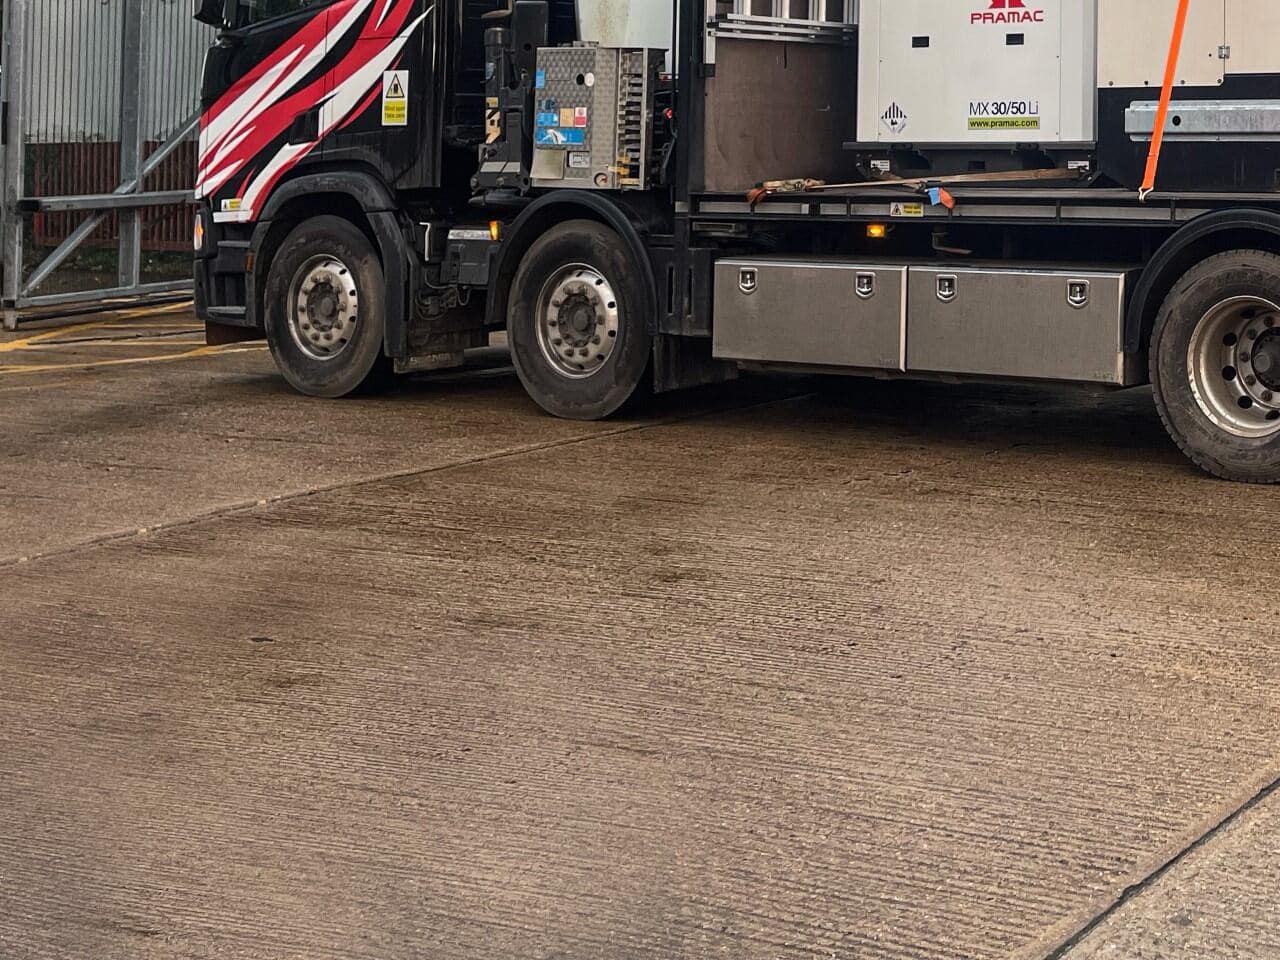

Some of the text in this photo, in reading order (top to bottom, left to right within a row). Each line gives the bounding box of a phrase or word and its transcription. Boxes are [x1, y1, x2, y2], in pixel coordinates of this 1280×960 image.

[970, 10, 1044, 25] PRAMAC
[969, 100, 1039, 116] MX 30/50 Li
[969, 119, 1038, 129] www.pramac.com
